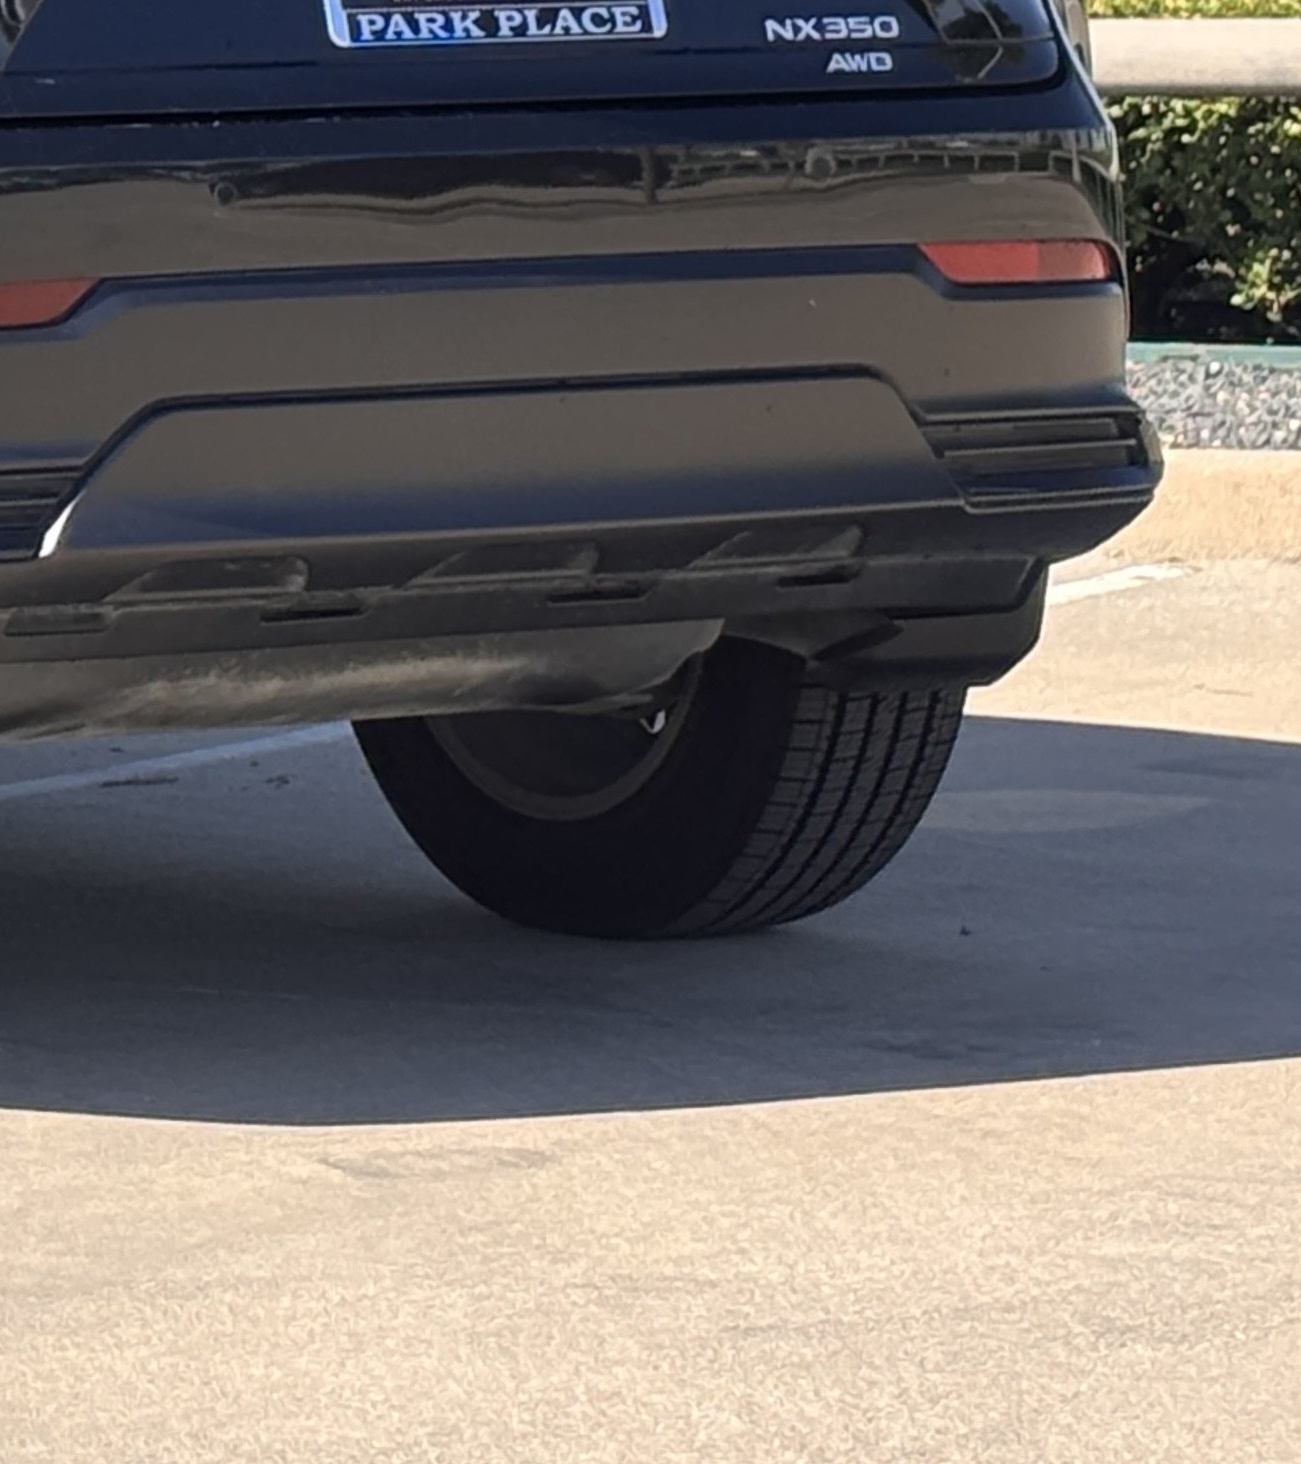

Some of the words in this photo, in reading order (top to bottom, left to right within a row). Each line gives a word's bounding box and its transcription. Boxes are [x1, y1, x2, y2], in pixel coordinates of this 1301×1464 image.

[356, 10, 487, 42] PARK
[493, 6, 644, 37] PLACE
[764, 15, 901, 43] NX350
[825, 50, 894, 74] AWD
